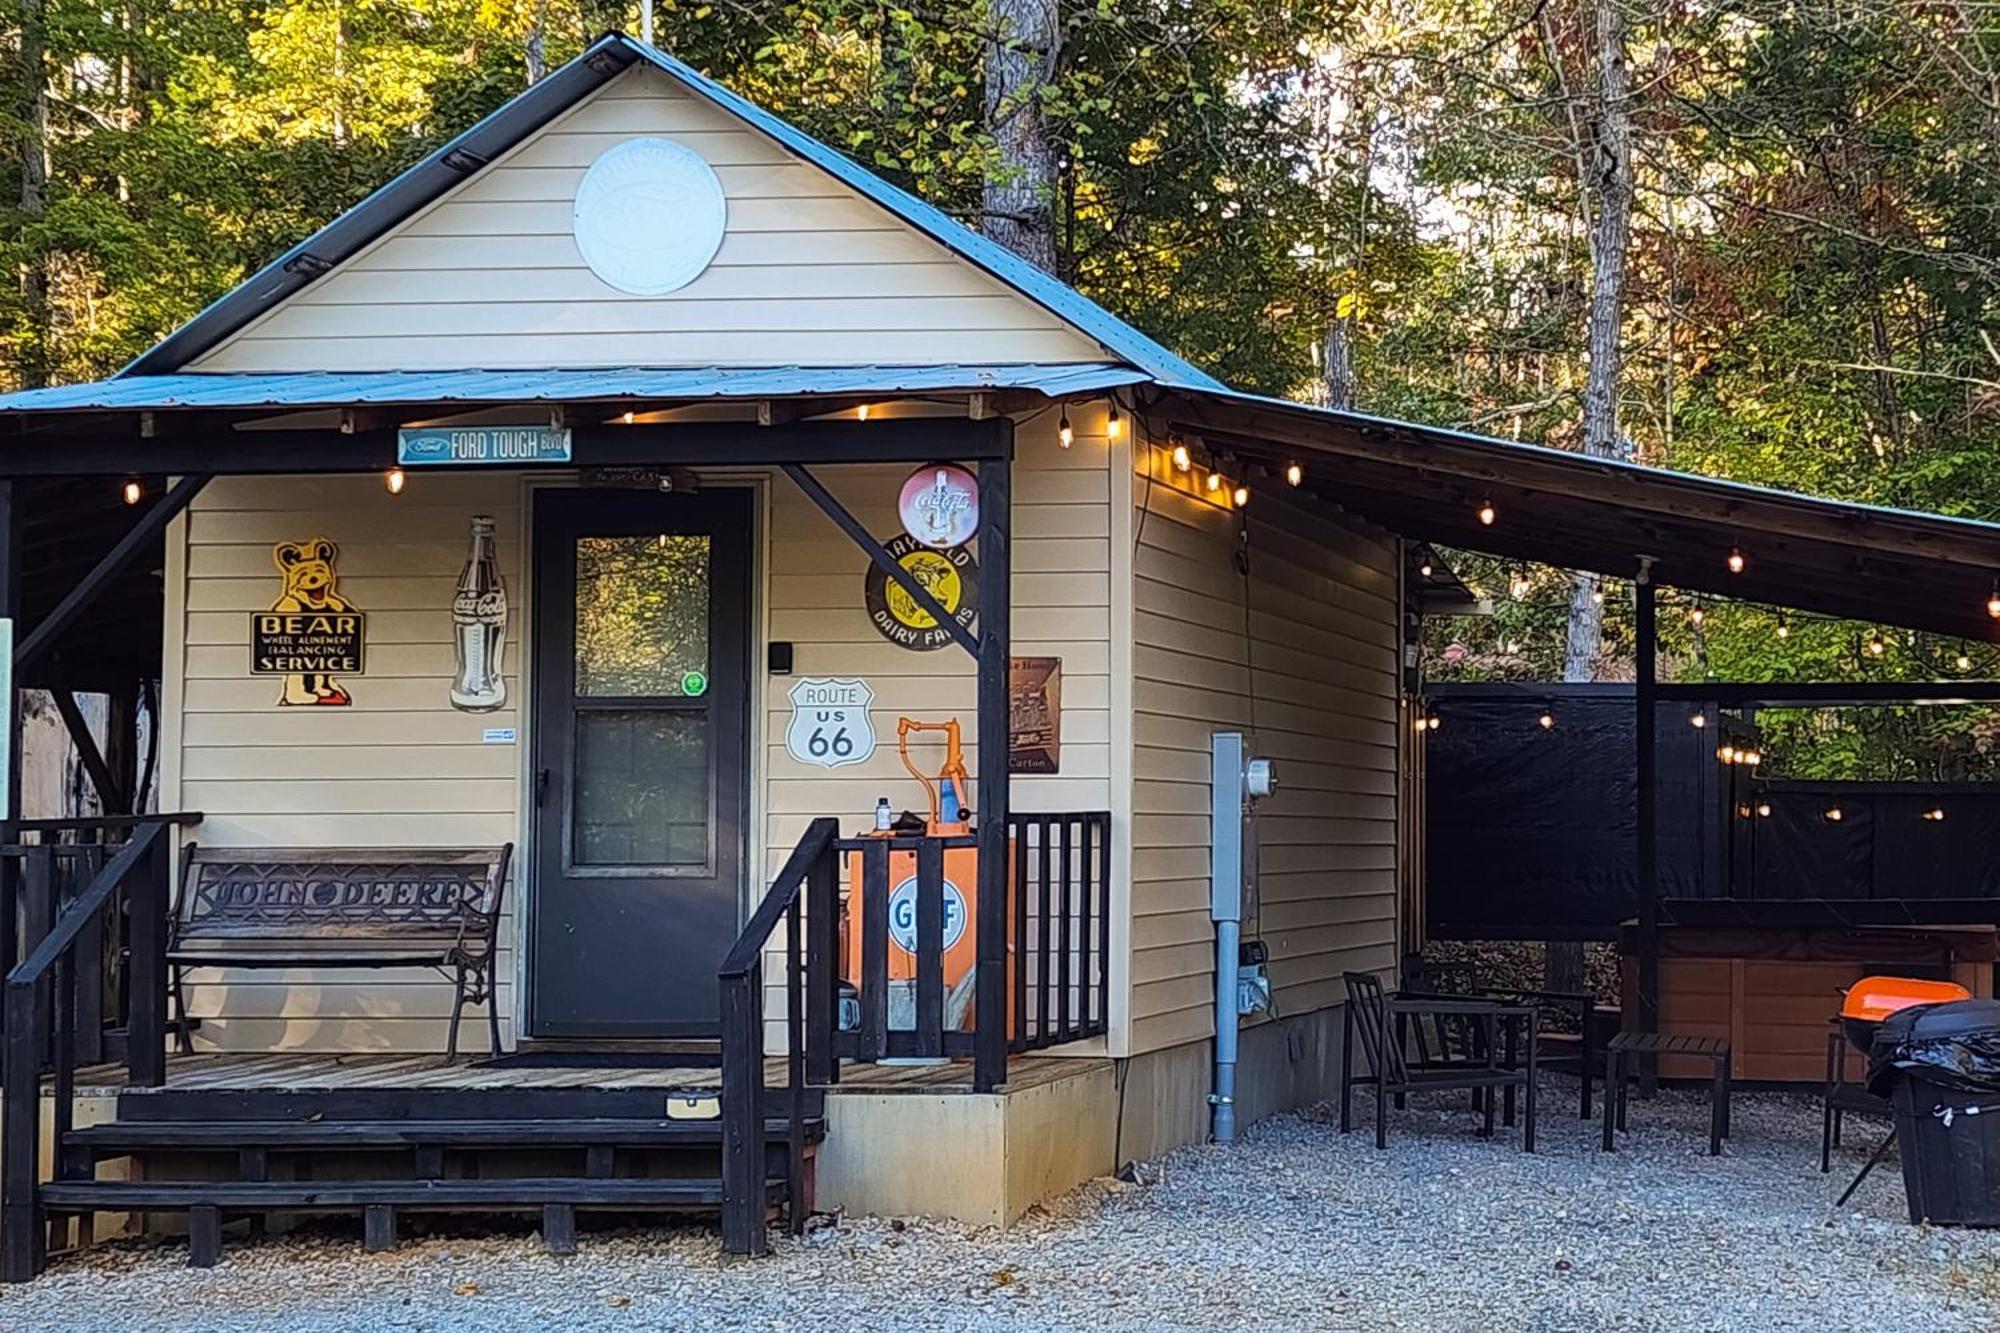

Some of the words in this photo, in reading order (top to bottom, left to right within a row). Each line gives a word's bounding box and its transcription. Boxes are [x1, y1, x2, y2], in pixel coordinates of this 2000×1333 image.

[451, 432, 486, 458] FORD
[491, 431, 538, 458] TOUGH
[540, 434, 563, 450] BLVD
[261, 616, 355, 634] BEAR
[873, 610, 918, 645] DAIRY
[261, 635, 294, 645] WHEEL
[268, 645, 346, 655] BALANCING
[260, 656, 355, 670] SERVICE
[806, 688, 857, 703] ROUTE
[816, 711, 845, 722] US
[808, 727, 853, 757] 66
[218, 881, 307, 906] JOHN
[342, 881, 462, 906] DEERE
[894, 899, 956, 929] GF
